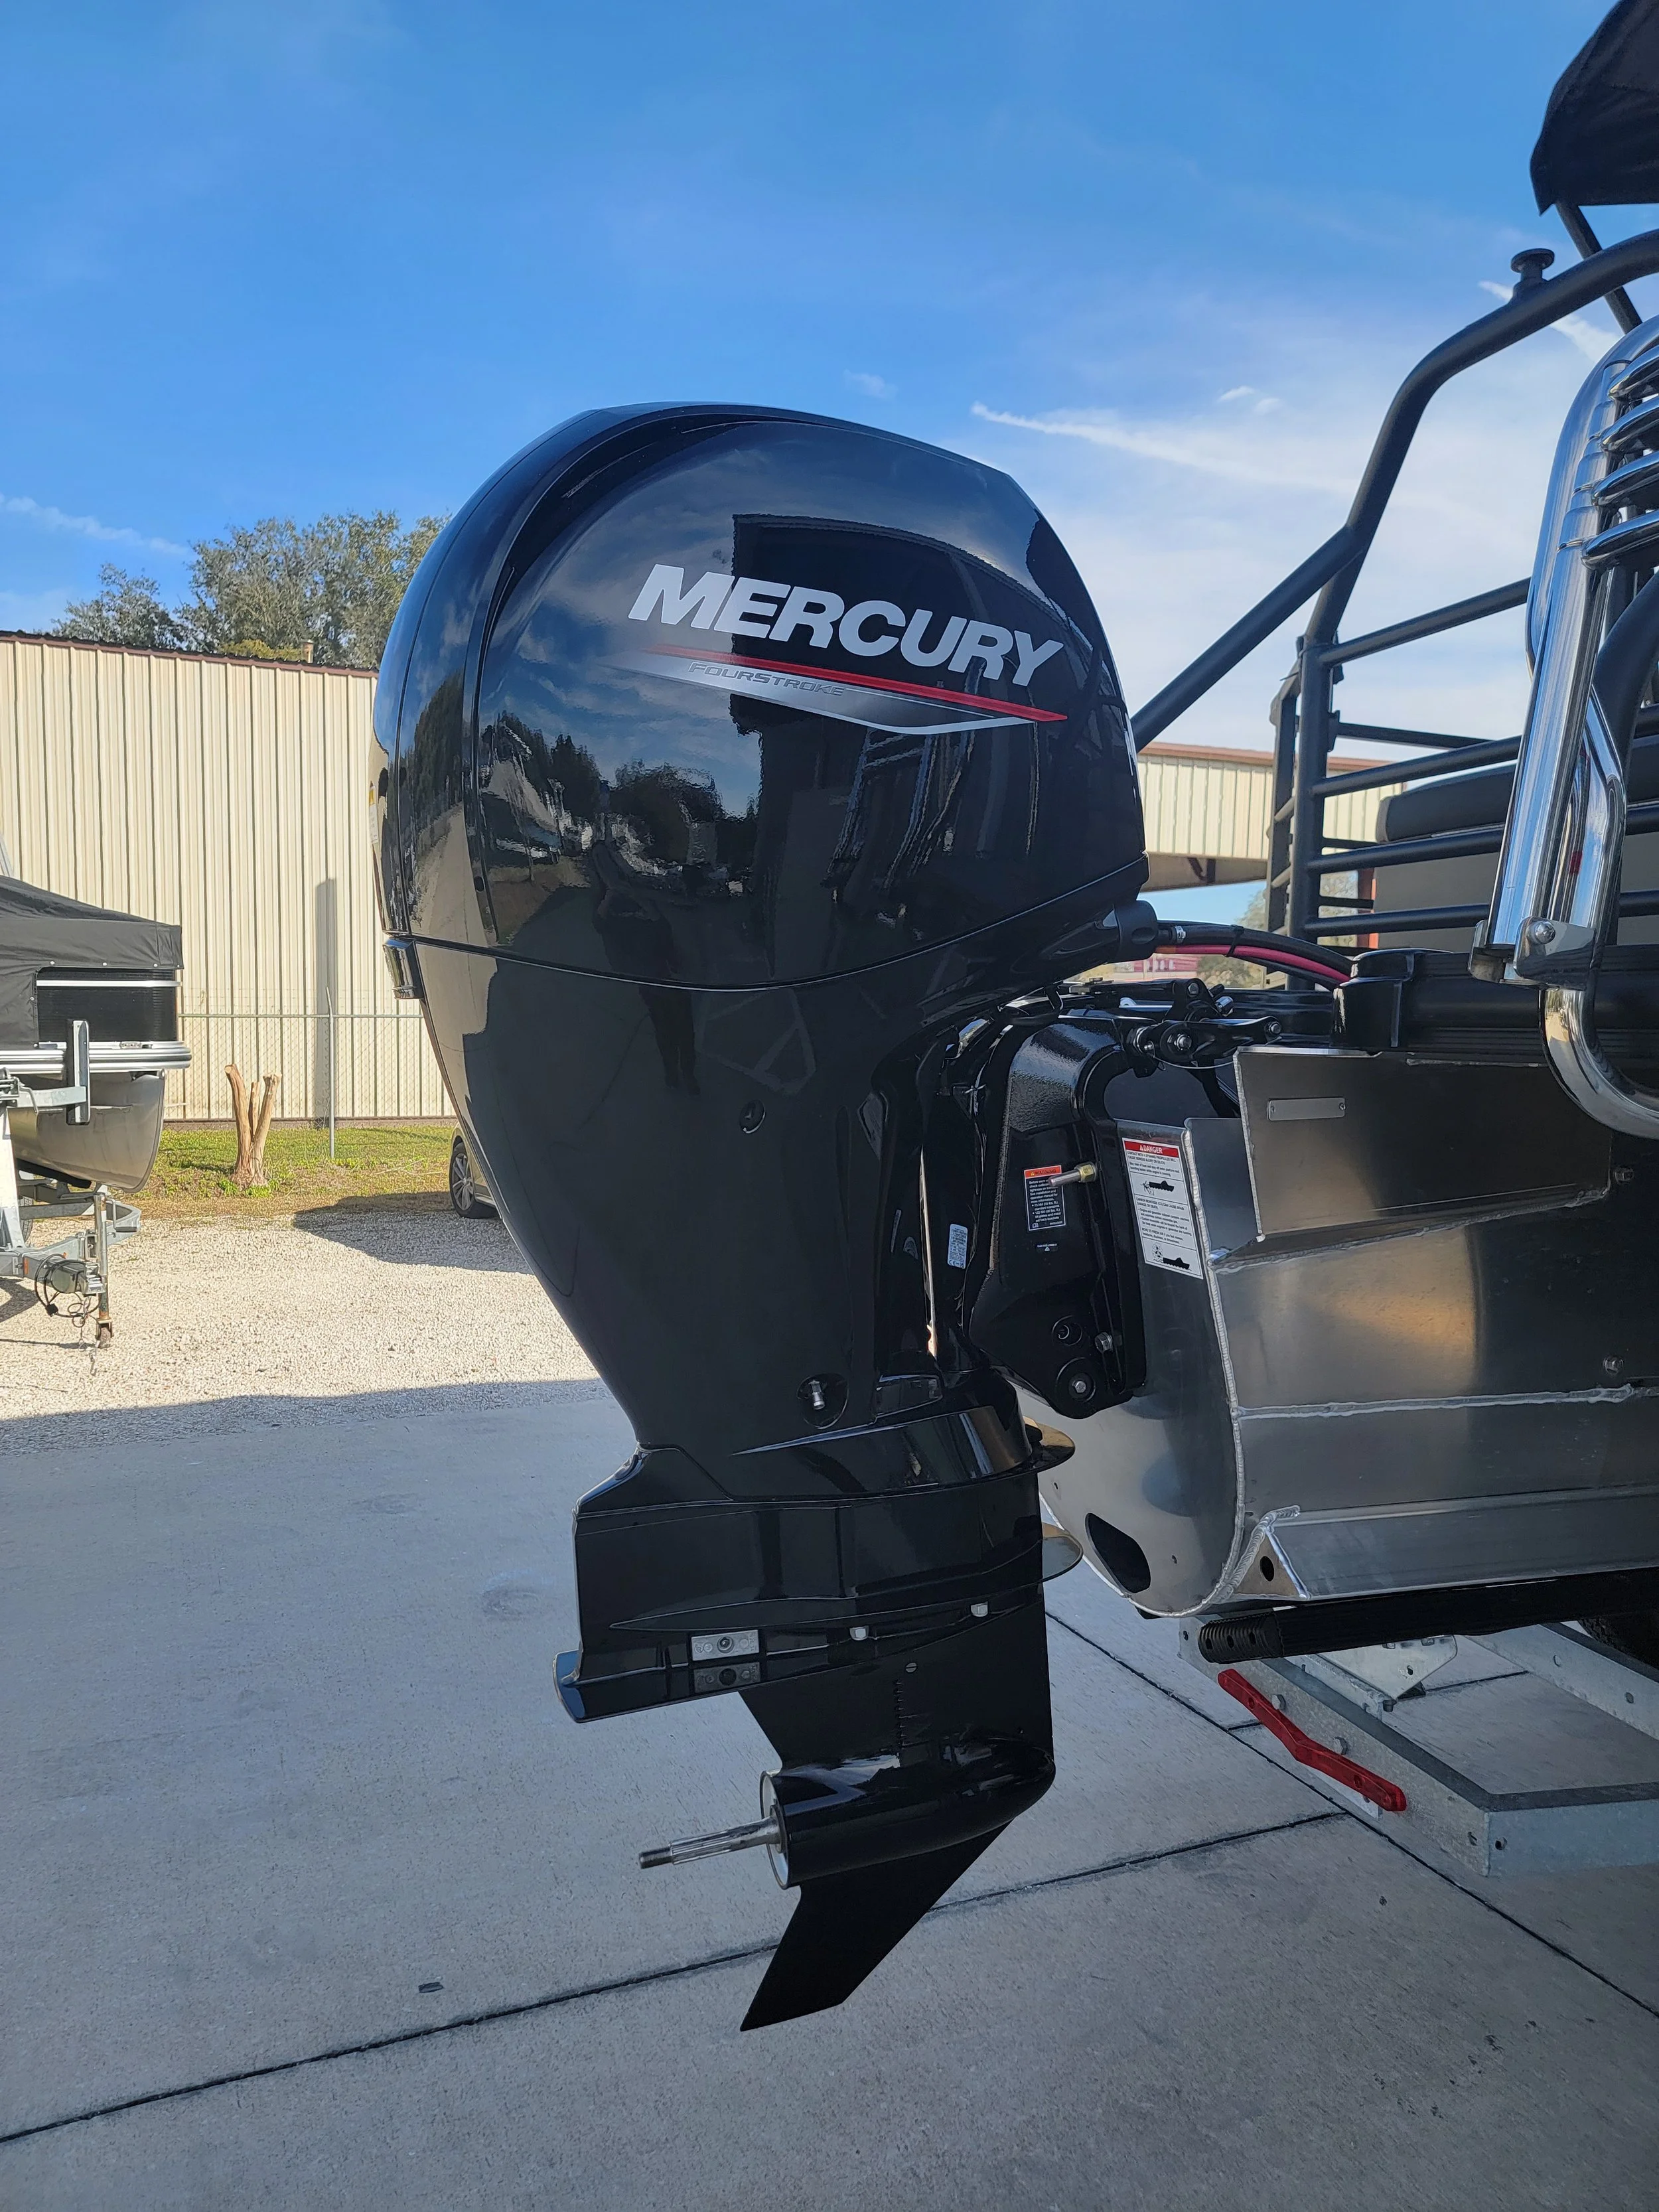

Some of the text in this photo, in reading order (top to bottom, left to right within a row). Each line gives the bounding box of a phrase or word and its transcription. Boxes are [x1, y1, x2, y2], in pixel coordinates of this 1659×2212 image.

[628, 563, 1063, 686] MERCURY
[688, 662, 845, 696] FOURSTROKE
[1143, 1145, 1163, 1154] DANGER
